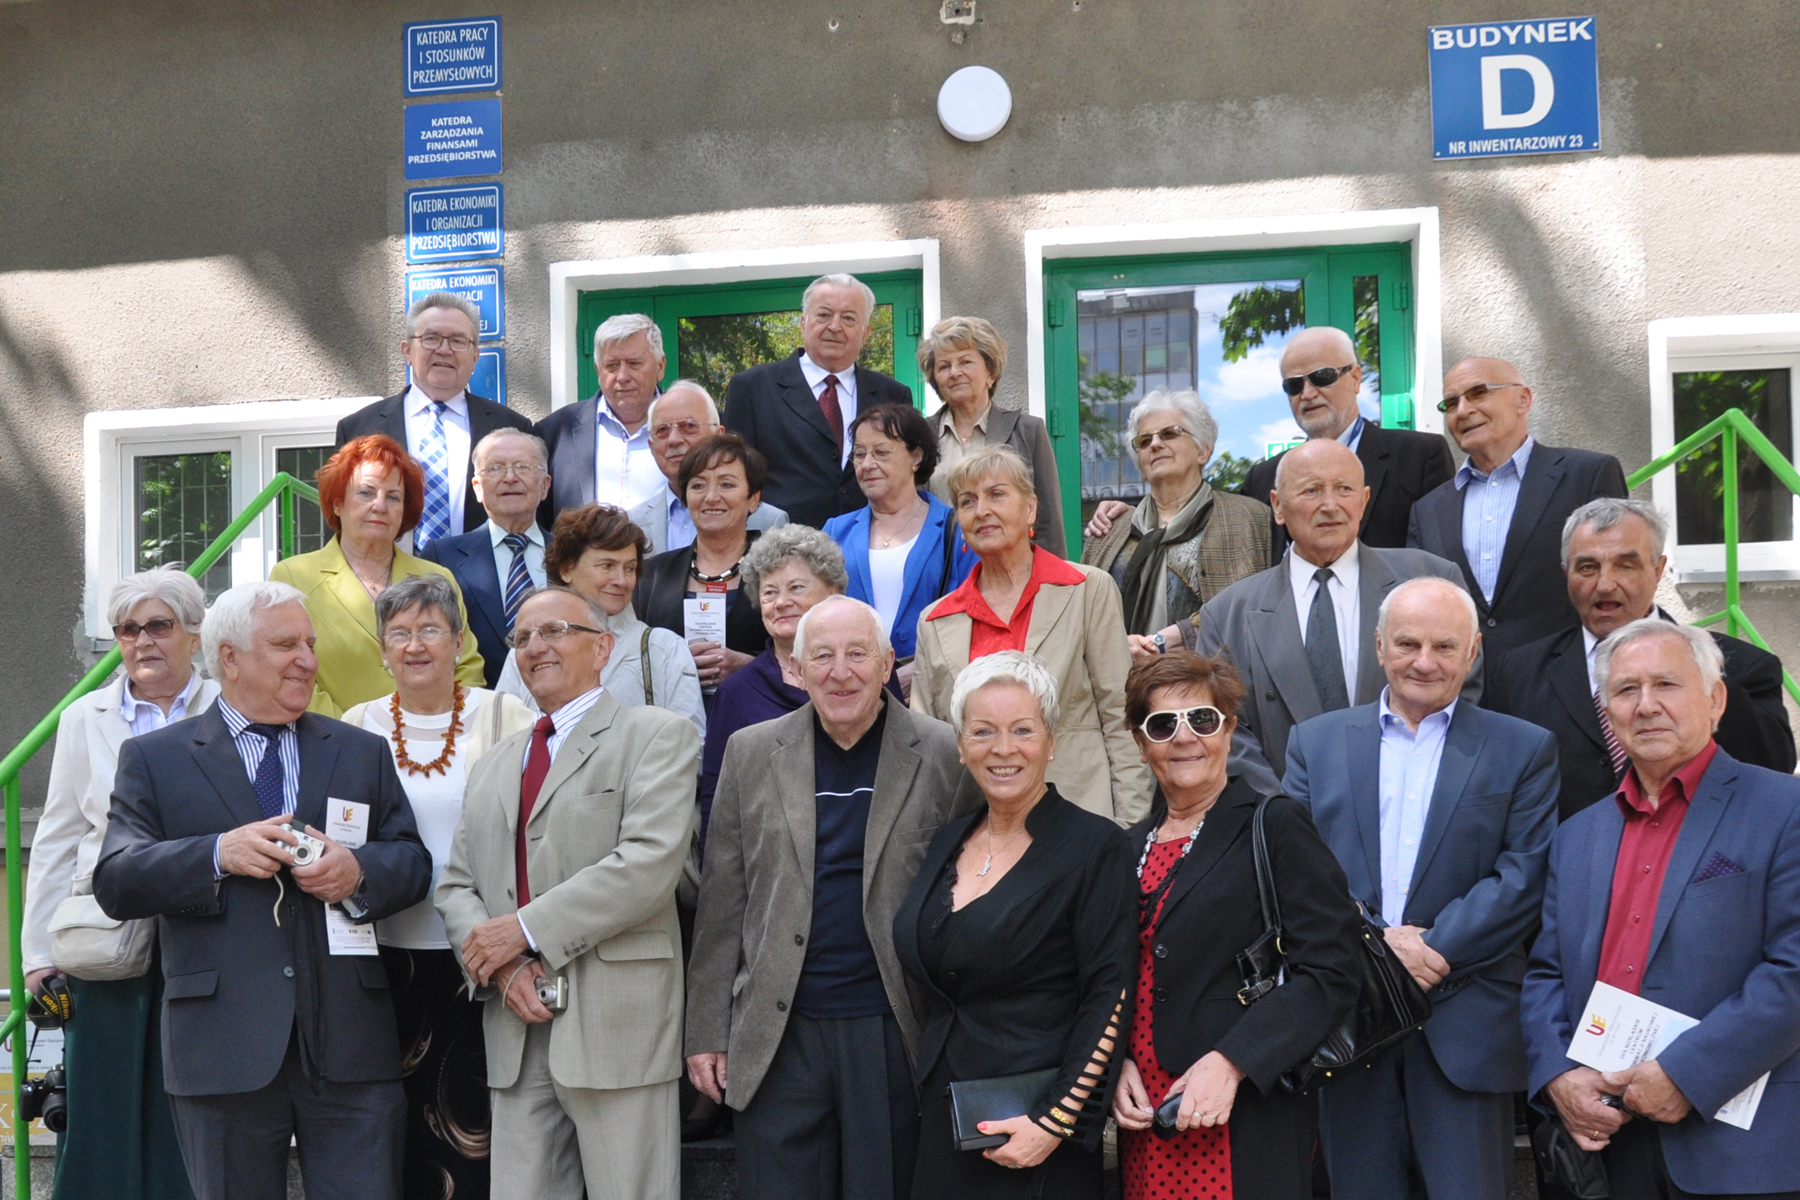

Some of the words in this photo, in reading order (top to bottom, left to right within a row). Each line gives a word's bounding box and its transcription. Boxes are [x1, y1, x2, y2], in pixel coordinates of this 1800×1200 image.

[417, 30, 457, 46] KATEDRA
[460, 27, 488, 42] PRACY
[1433, 21, 1592, 50] BUDYNEK
[419, 51, 423, 64] I
[426, 43, 485, 64] STOSUNKÓW
[413, 65, 493, 84] PRZEMYSŁOWYCH
[1481, 54, 1555, 130] D
[431, 116, 473, 127] KATEDRA
[420, 127, 484, 139] ZARZĄDZANIA
[426, 139, 478, 151] FINANSAMI
[1449, 141, 1466, 154] NR
[1469, 135, 1567, 153] INWENTARZOWY
[1569, 134, 1583, 148] 23
[408, 149, 497, 164] PRZEDSIĘBIORSTWA
[413, 198, 448, 213] KATEDRA
[450, 194, 496, 211] EKONOMIKI
[426, 218, 429, 231] I
[431, 214, 483, 231] ORGANIZACJI
[412, 231, 497, 251] PRZEDSIĘBIORSTWA
[412, 277, 448, 291] KATEDRA
[449, 274, 496, 289] EKONOMIKI
[59, 994, 69, 1020] Nikon
[1586, 1014, 1606, 1036] UE
